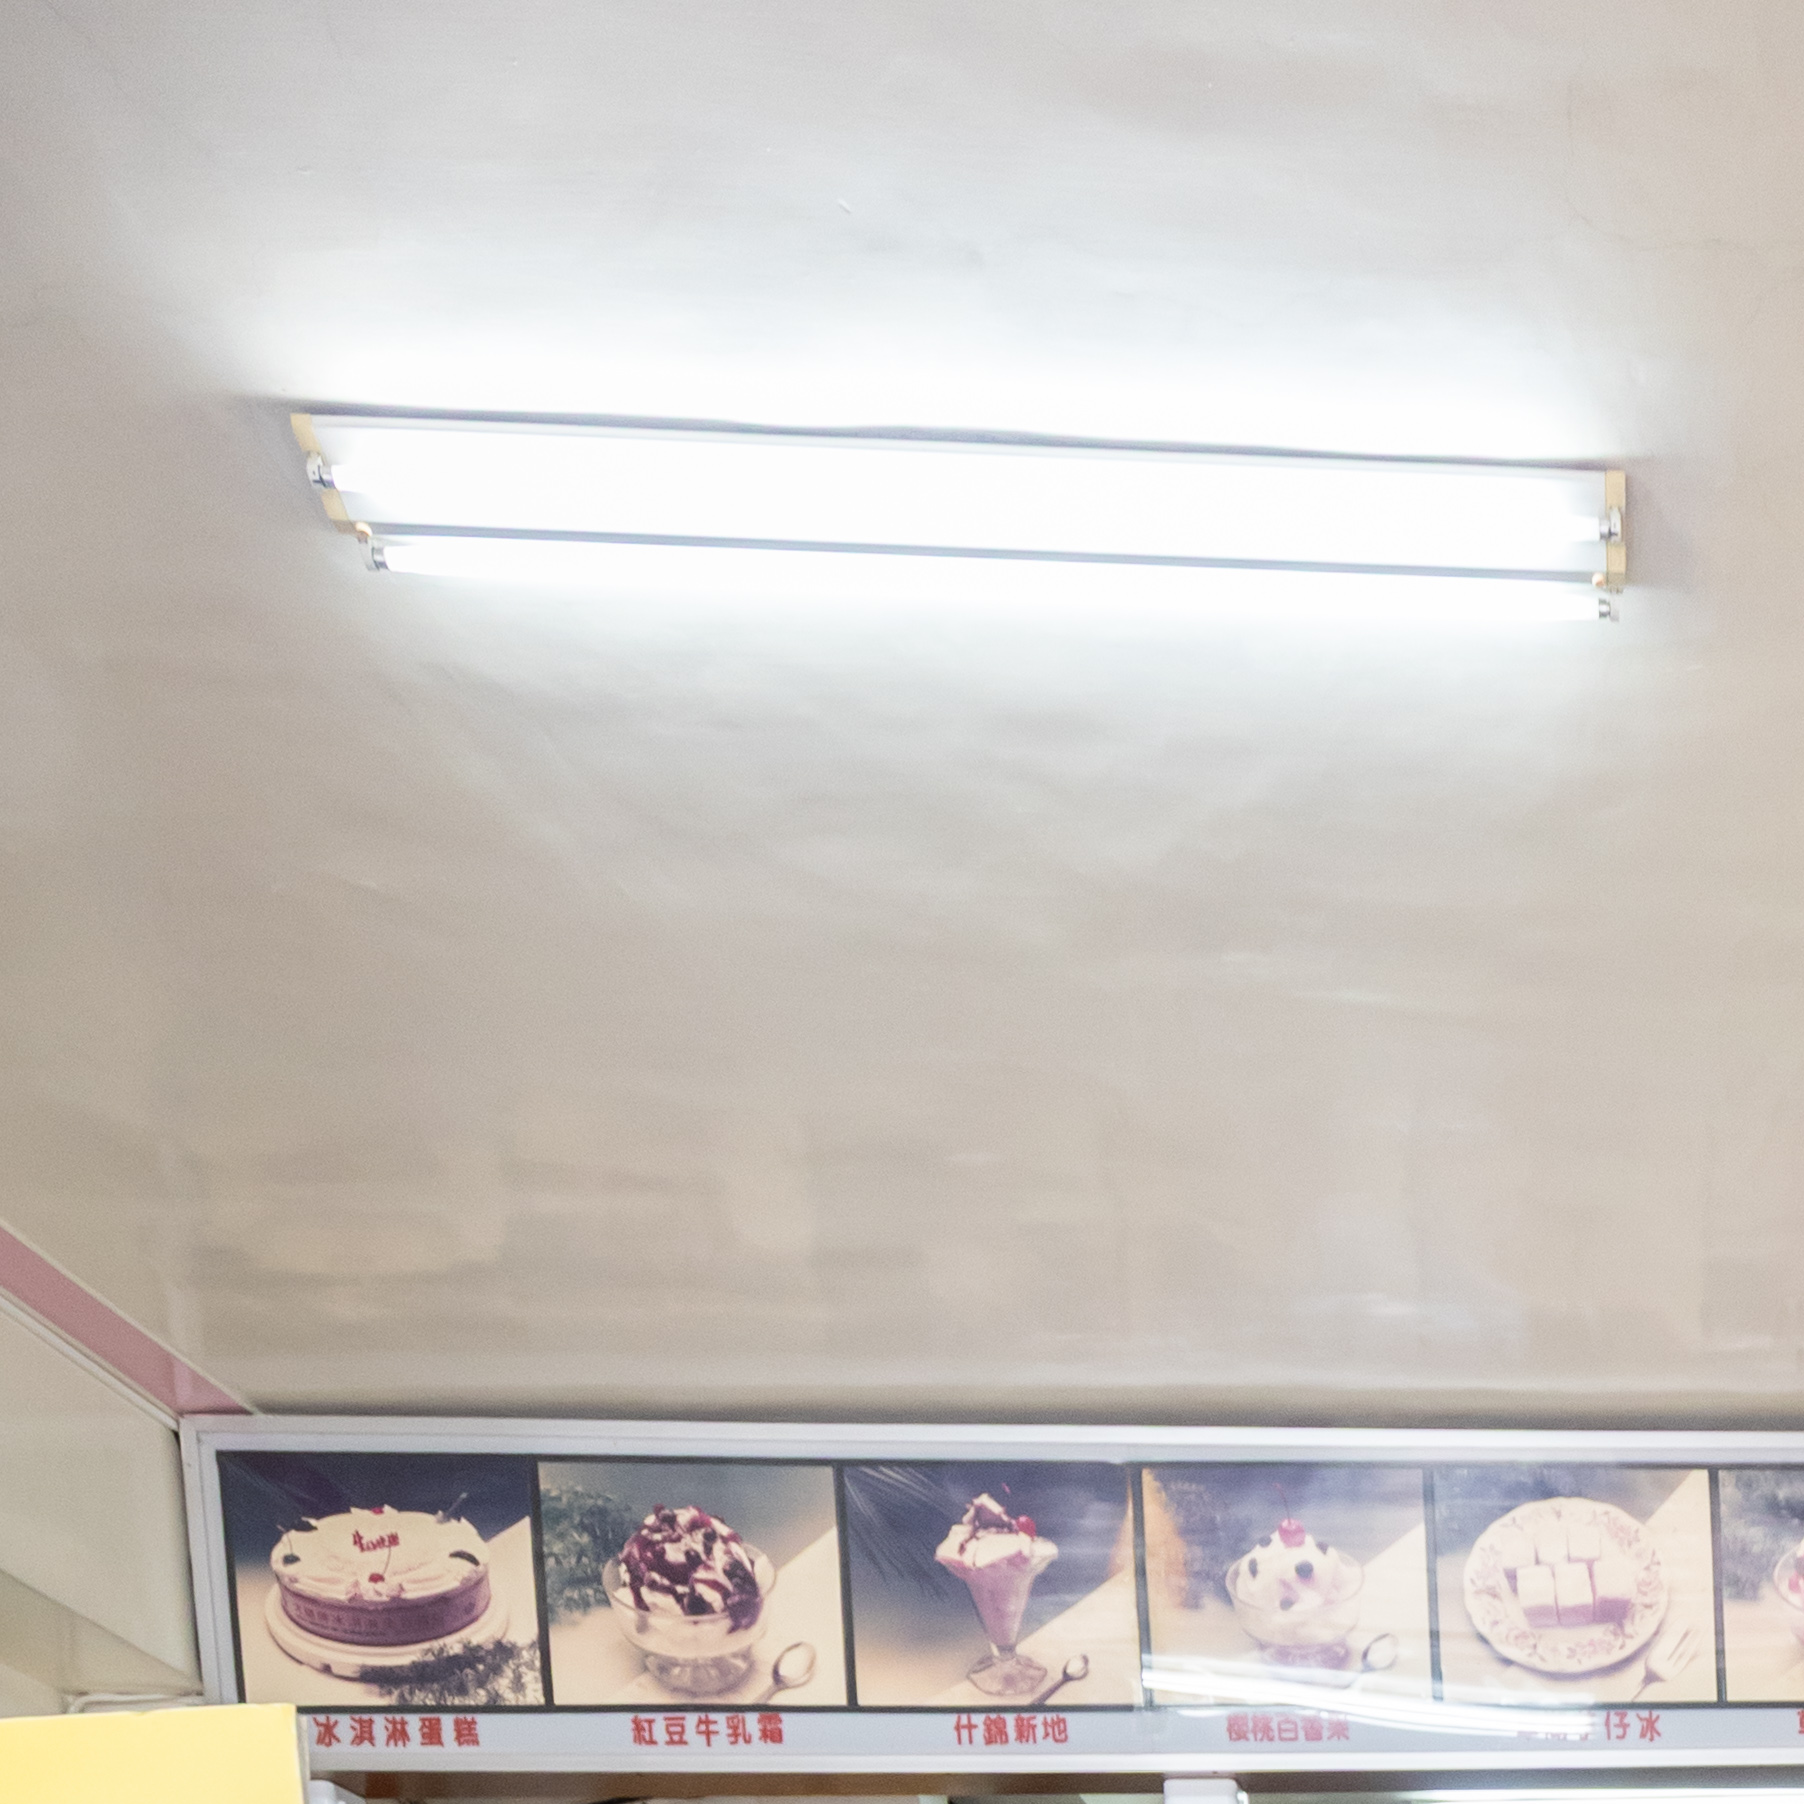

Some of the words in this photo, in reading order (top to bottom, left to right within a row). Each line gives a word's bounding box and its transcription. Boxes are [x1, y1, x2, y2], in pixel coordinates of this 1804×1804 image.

[312, 1715, 480, 1748] 冰淇淋蛋糕
[631, 1714, 784, 1746] 紅豆牛乳霜
[953, 1713, 1068, 1746] 什錦新地
